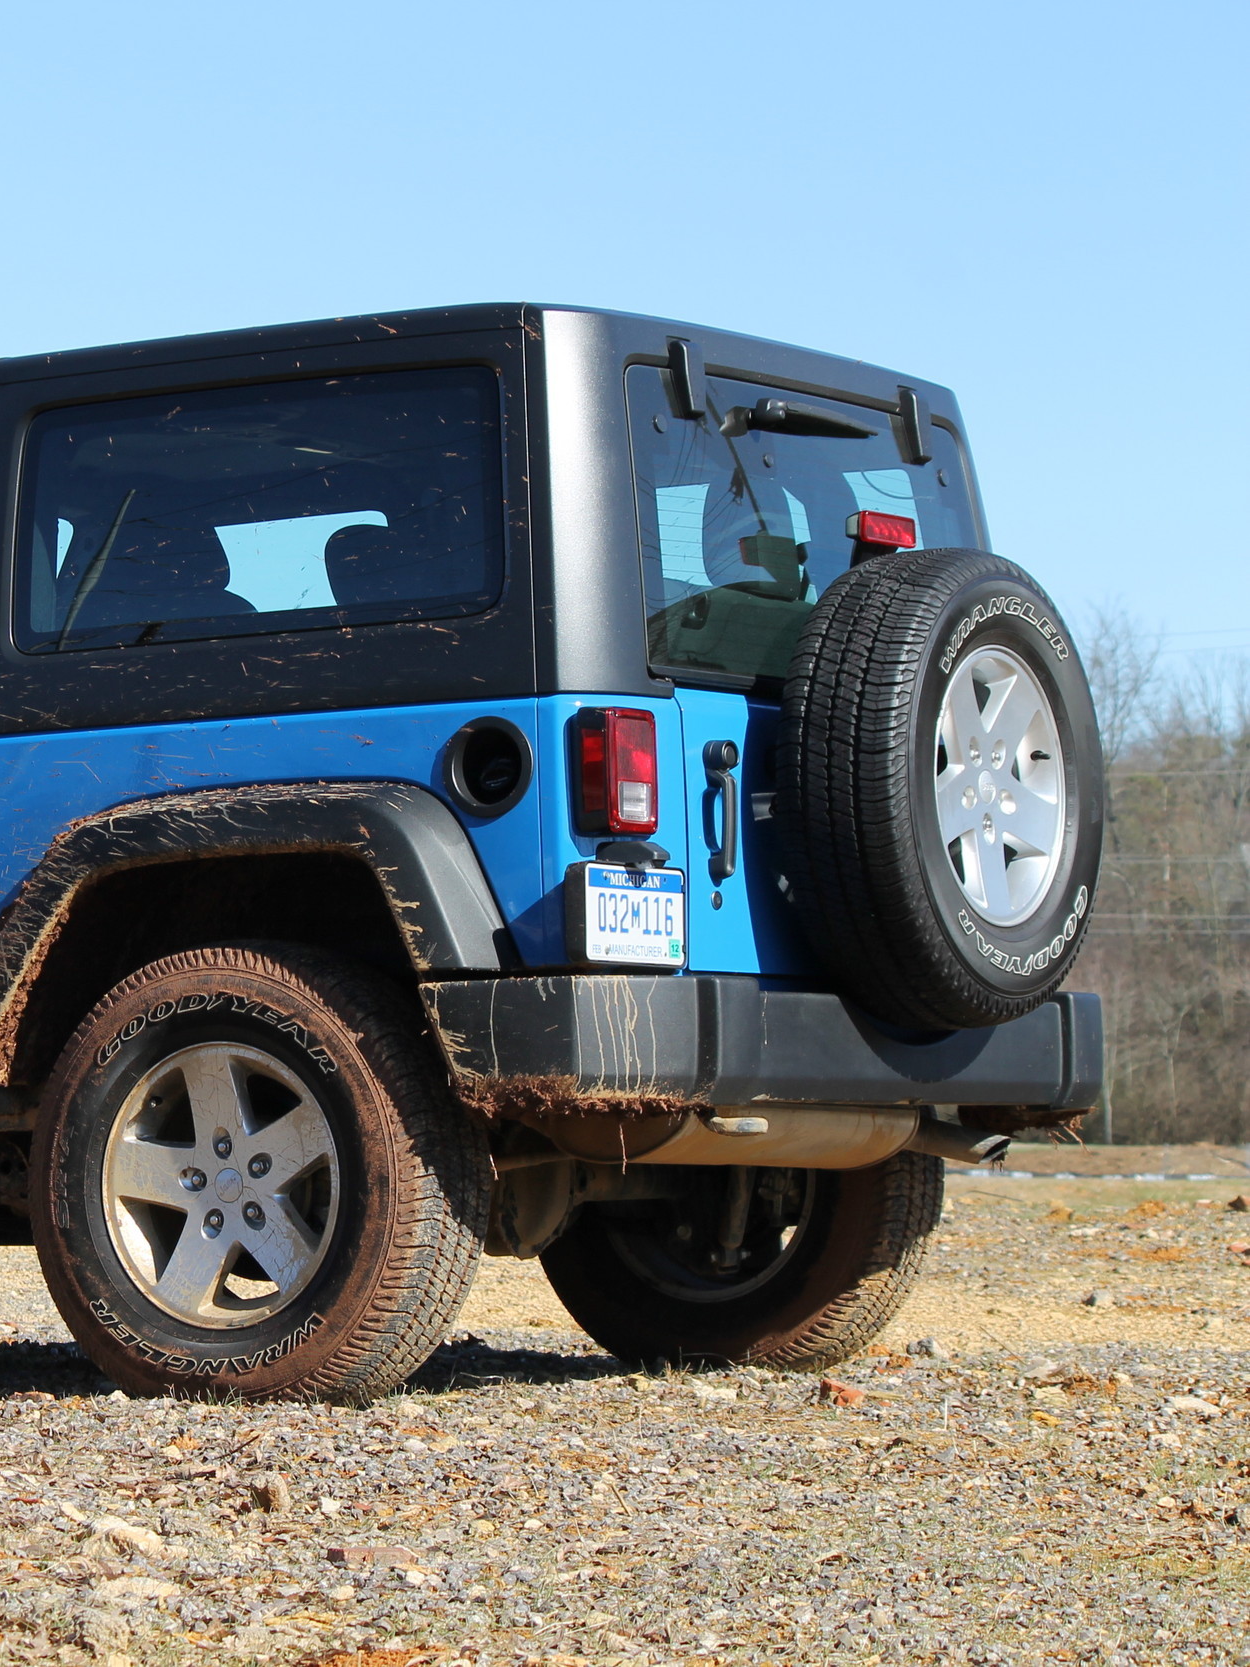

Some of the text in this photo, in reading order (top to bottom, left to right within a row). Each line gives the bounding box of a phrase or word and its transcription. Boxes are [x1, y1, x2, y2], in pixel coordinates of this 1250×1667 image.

[938, 596, 1069, 674] WRANGLER
[609, 870, 661, 889] MICHIGAN
[597, 892, 674, 937] 032M116
[957, 885, 1088, 976] GOODYEAR
[608, 943, 663, 957] MANUFACTURER
[670, 944, 680, 953] 12
[96, 993, 338, 1075] GOODYEAR
[89, 1298, 328, 1377] WRANGLER
